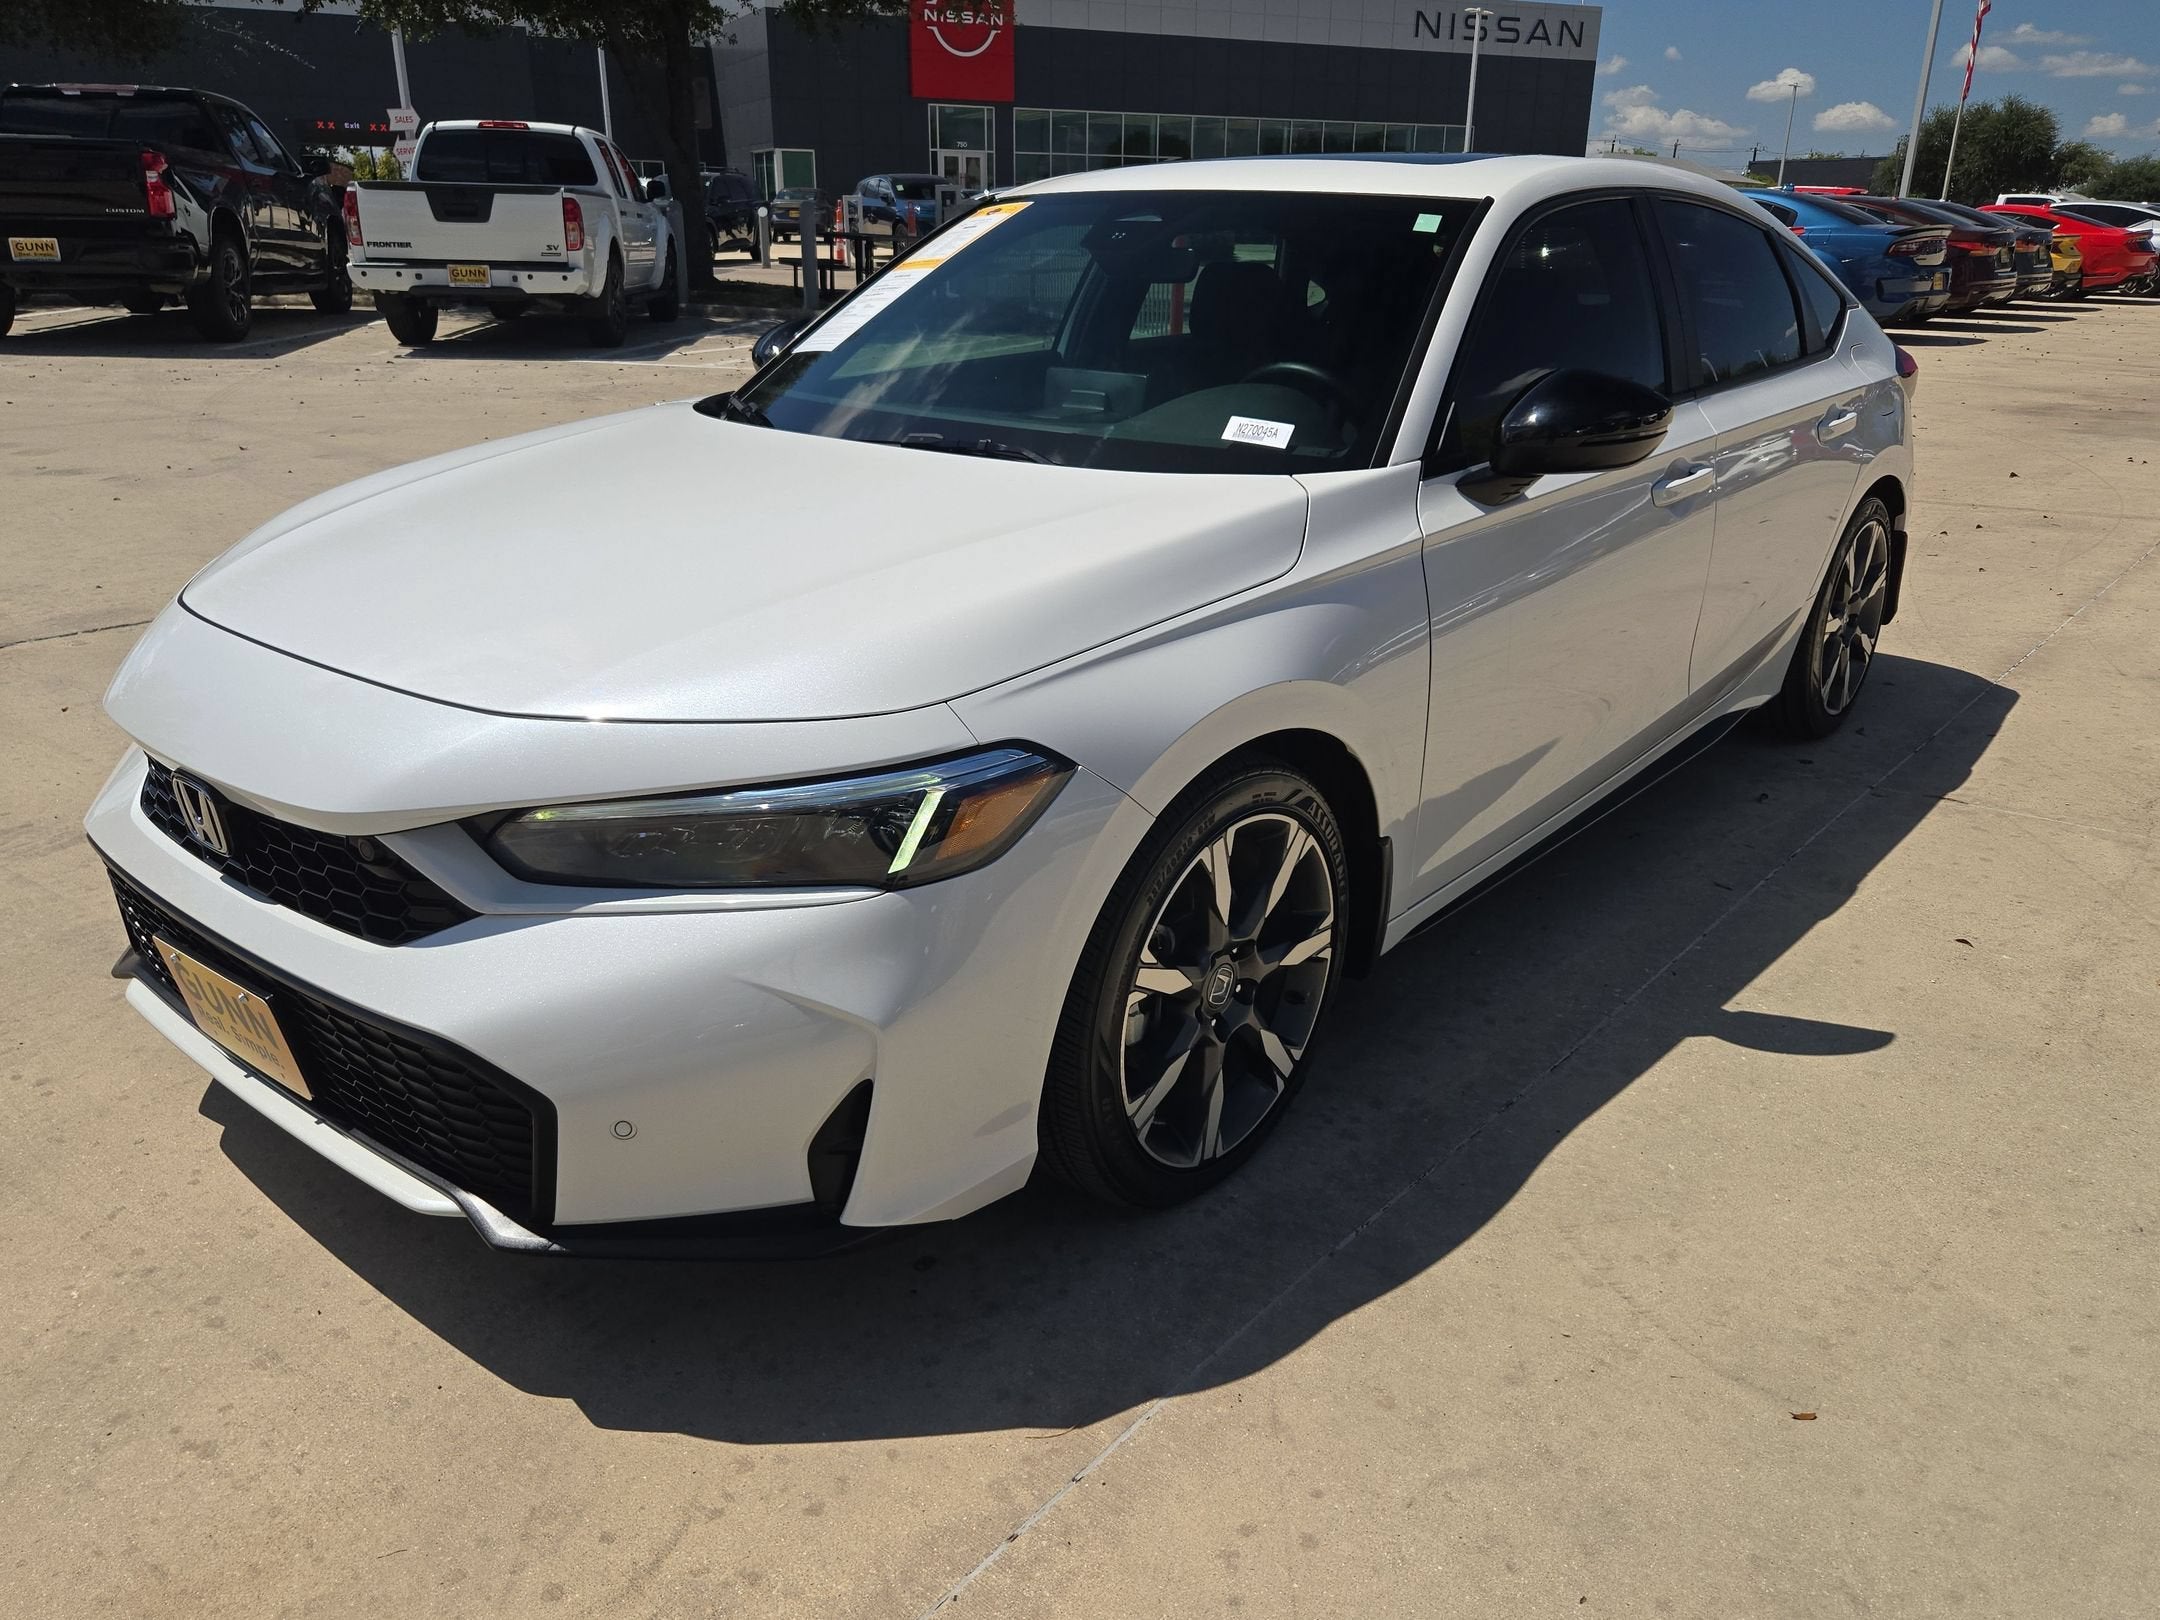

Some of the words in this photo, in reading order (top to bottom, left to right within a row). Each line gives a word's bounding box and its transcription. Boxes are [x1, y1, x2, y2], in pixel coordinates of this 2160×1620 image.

[924, 9, 1003, 26] NISSAN
[1415, 10, 1584, 48] NISSAN
[395, 116, 414, 124] SALES
[15, 242, 54, 251] GUNN
[367, 241, 413, 249] FRONTIER
[452, 269, 486, 278] GUNN
[1236, 423, 1279, 439] N270045A
[175, 961, 280, 1050] GUNN
